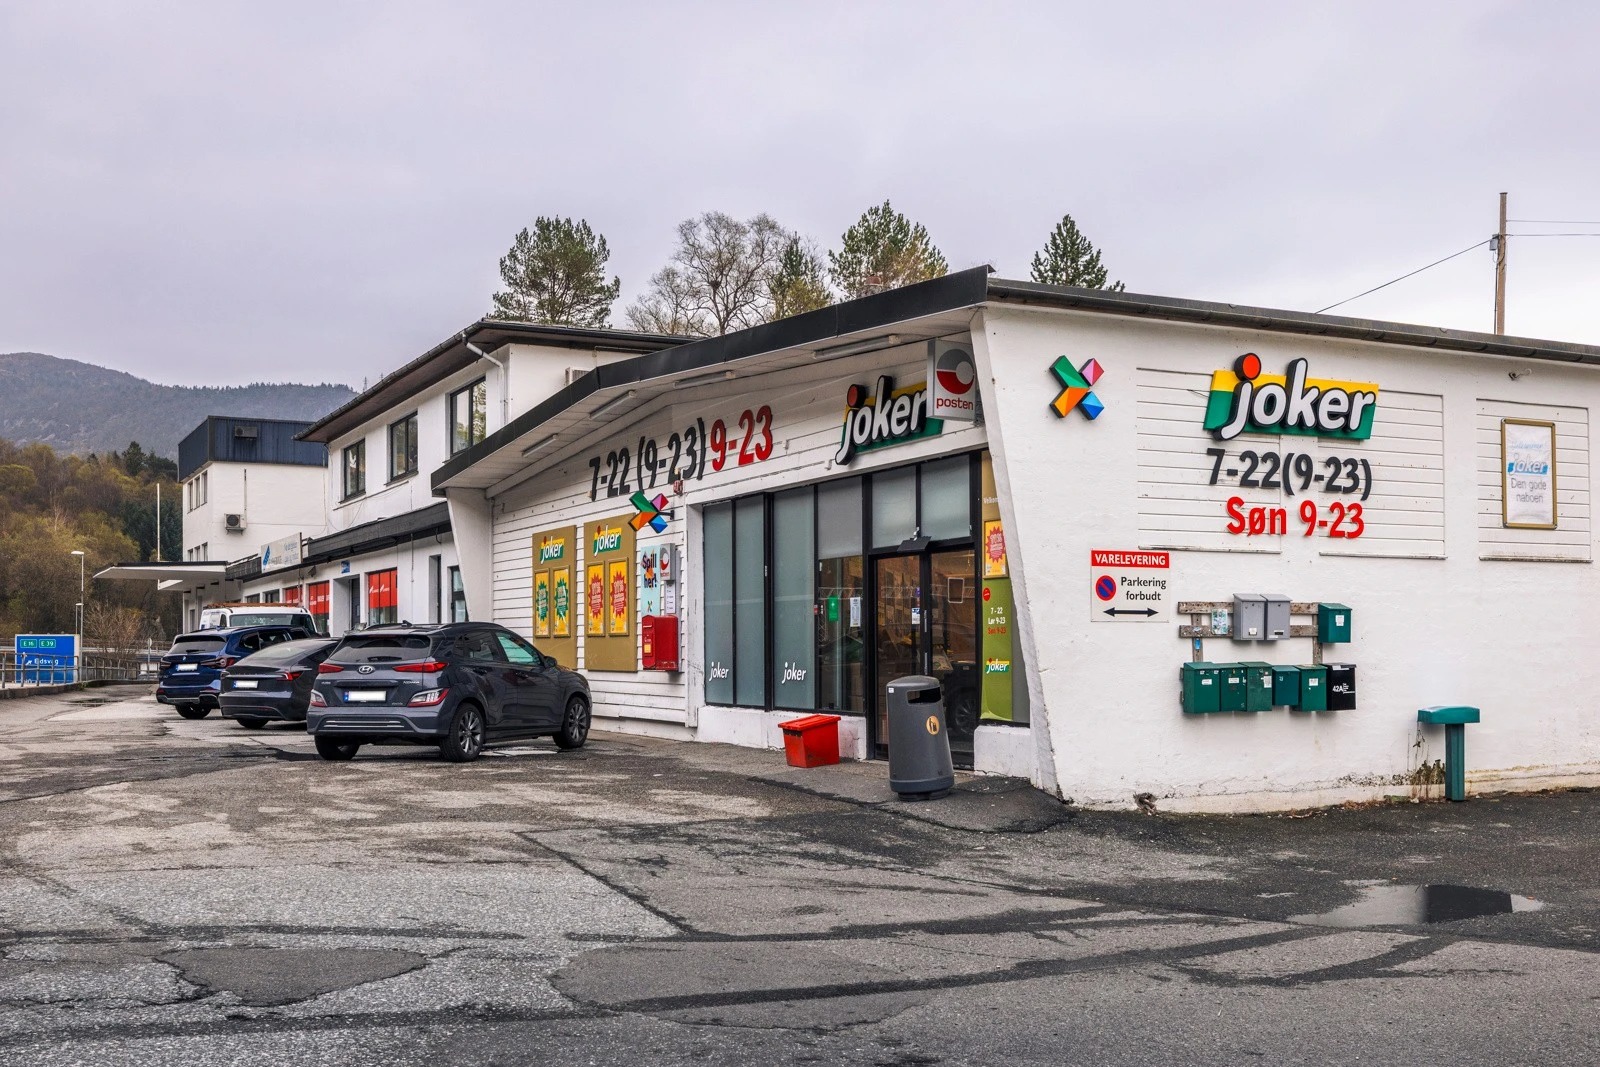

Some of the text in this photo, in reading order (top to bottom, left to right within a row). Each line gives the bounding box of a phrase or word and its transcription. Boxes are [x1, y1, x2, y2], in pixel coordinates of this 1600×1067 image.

[936, 396, 974, 411] posten
[1214, 353, 1376, 441] joker
[835, 375, 927, 465] joker
[589, 405, 773, 502] 7-22 (9-23) 9-23
[1509, 452, 1547, 476] joker
[1511, 478, 1547, 492] Den gode
[1516, 493, 1544, 503] naboen
[1226, 496, 1365, 538] Søn 9-23
[541, 535, 563, 564] joker
[594, 523, 621, 557] joker
[642, 553, 657, 572] Spill
[1094, 553, 1166, 566] VARELEVERING
[1120, 576, 1167, 590] Parkering
[1126, 590, 1162, 601] forbudt
[709, 661, 729, 681] joker
[781, 661, 806, 684] joker
[986, 658, 1008, 674] joker
